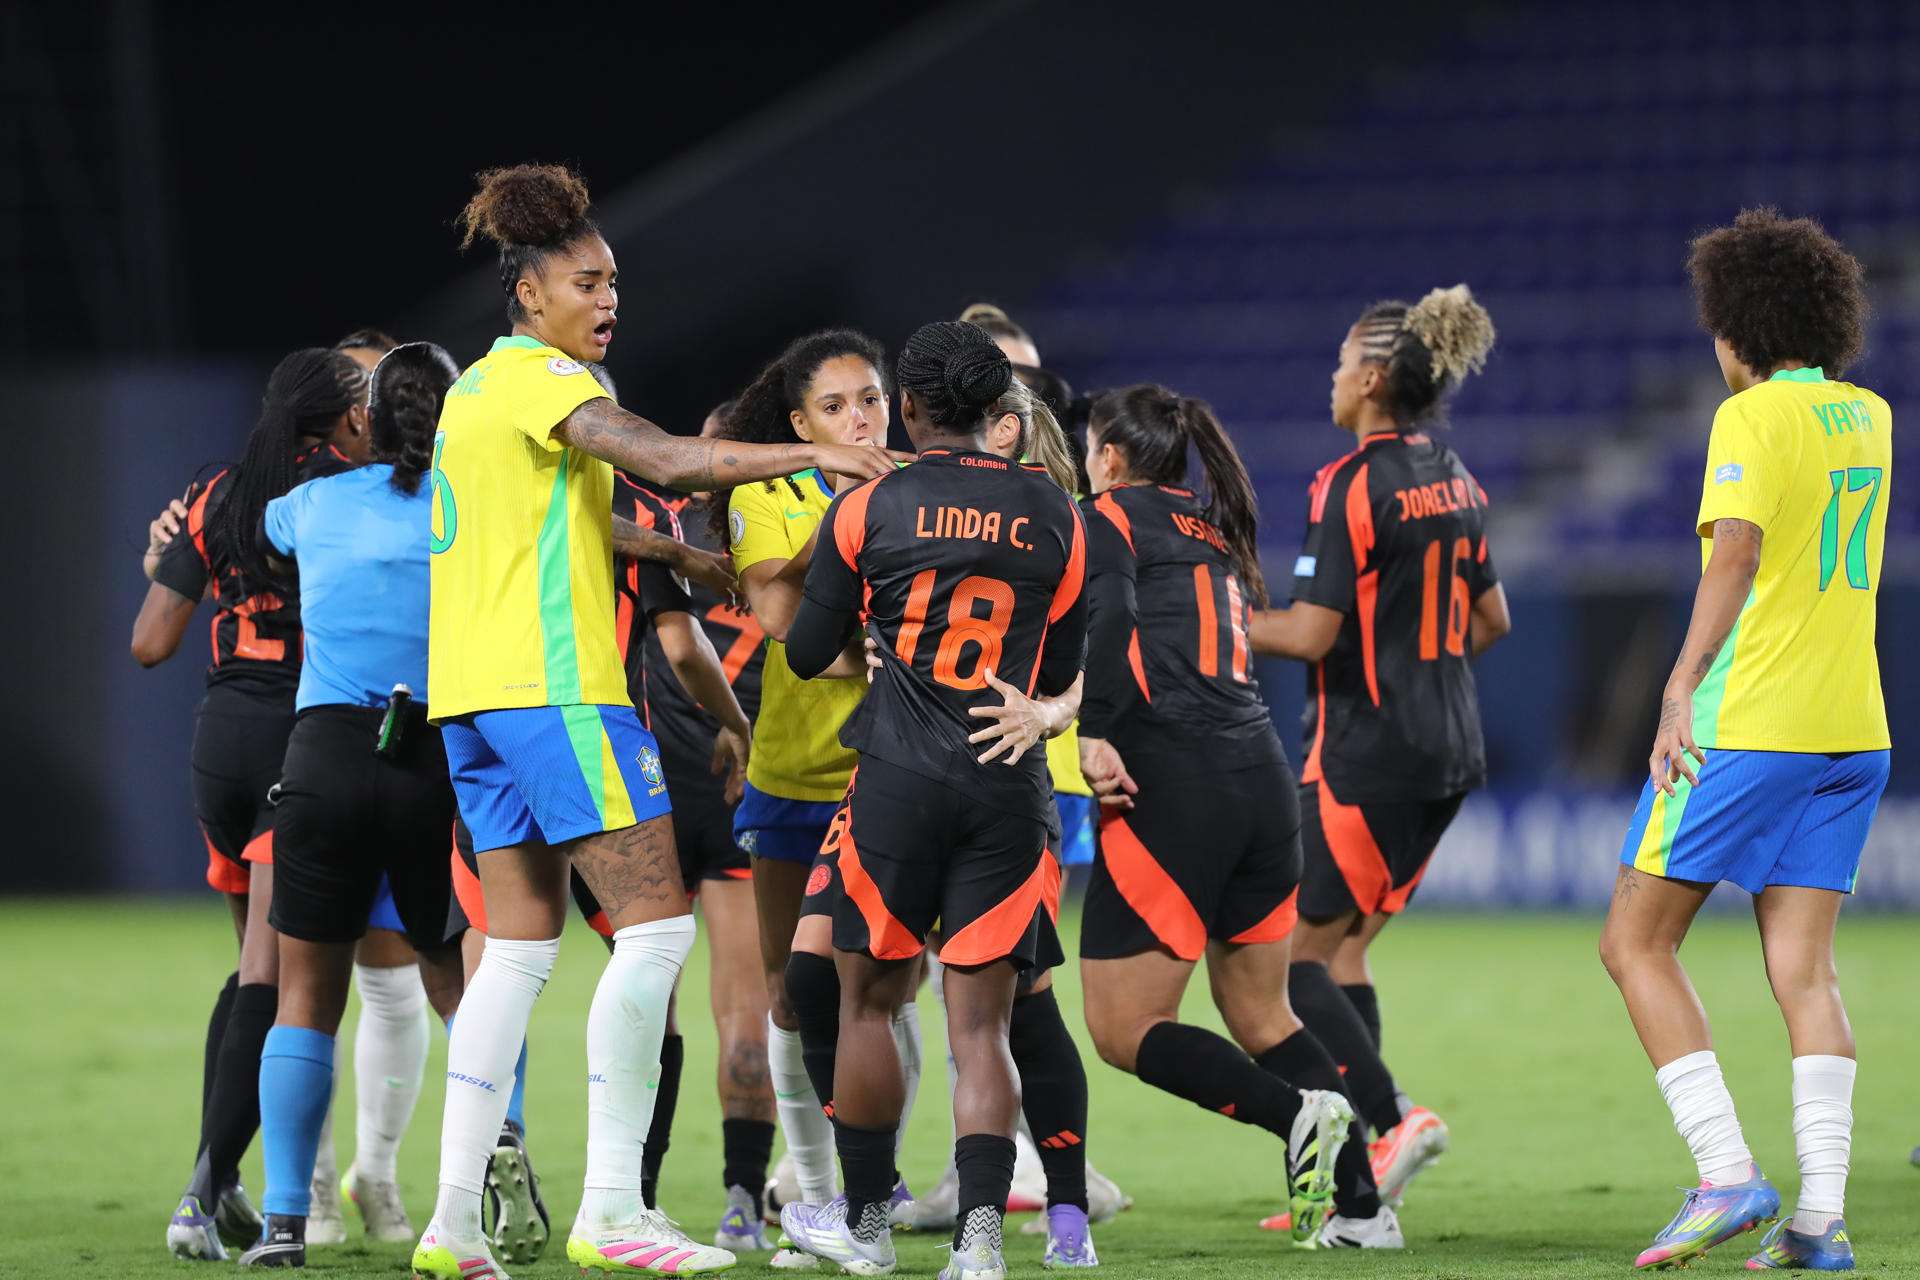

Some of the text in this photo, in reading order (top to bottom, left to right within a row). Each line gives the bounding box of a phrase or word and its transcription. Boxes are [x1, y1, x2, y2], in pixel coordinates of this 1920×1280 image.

[960, 456, 1008, 471] COLOMBIA
[1812, 400, 1873, 436] YAYA
[916, 506, 1034, 551] LINDA C.
[1819, 467, 1882, 592] 17
[895, 569, 1016, 691] 18
[1193, 564, 1249, 683] 11
[1419, 536, 1471, 660] 16
